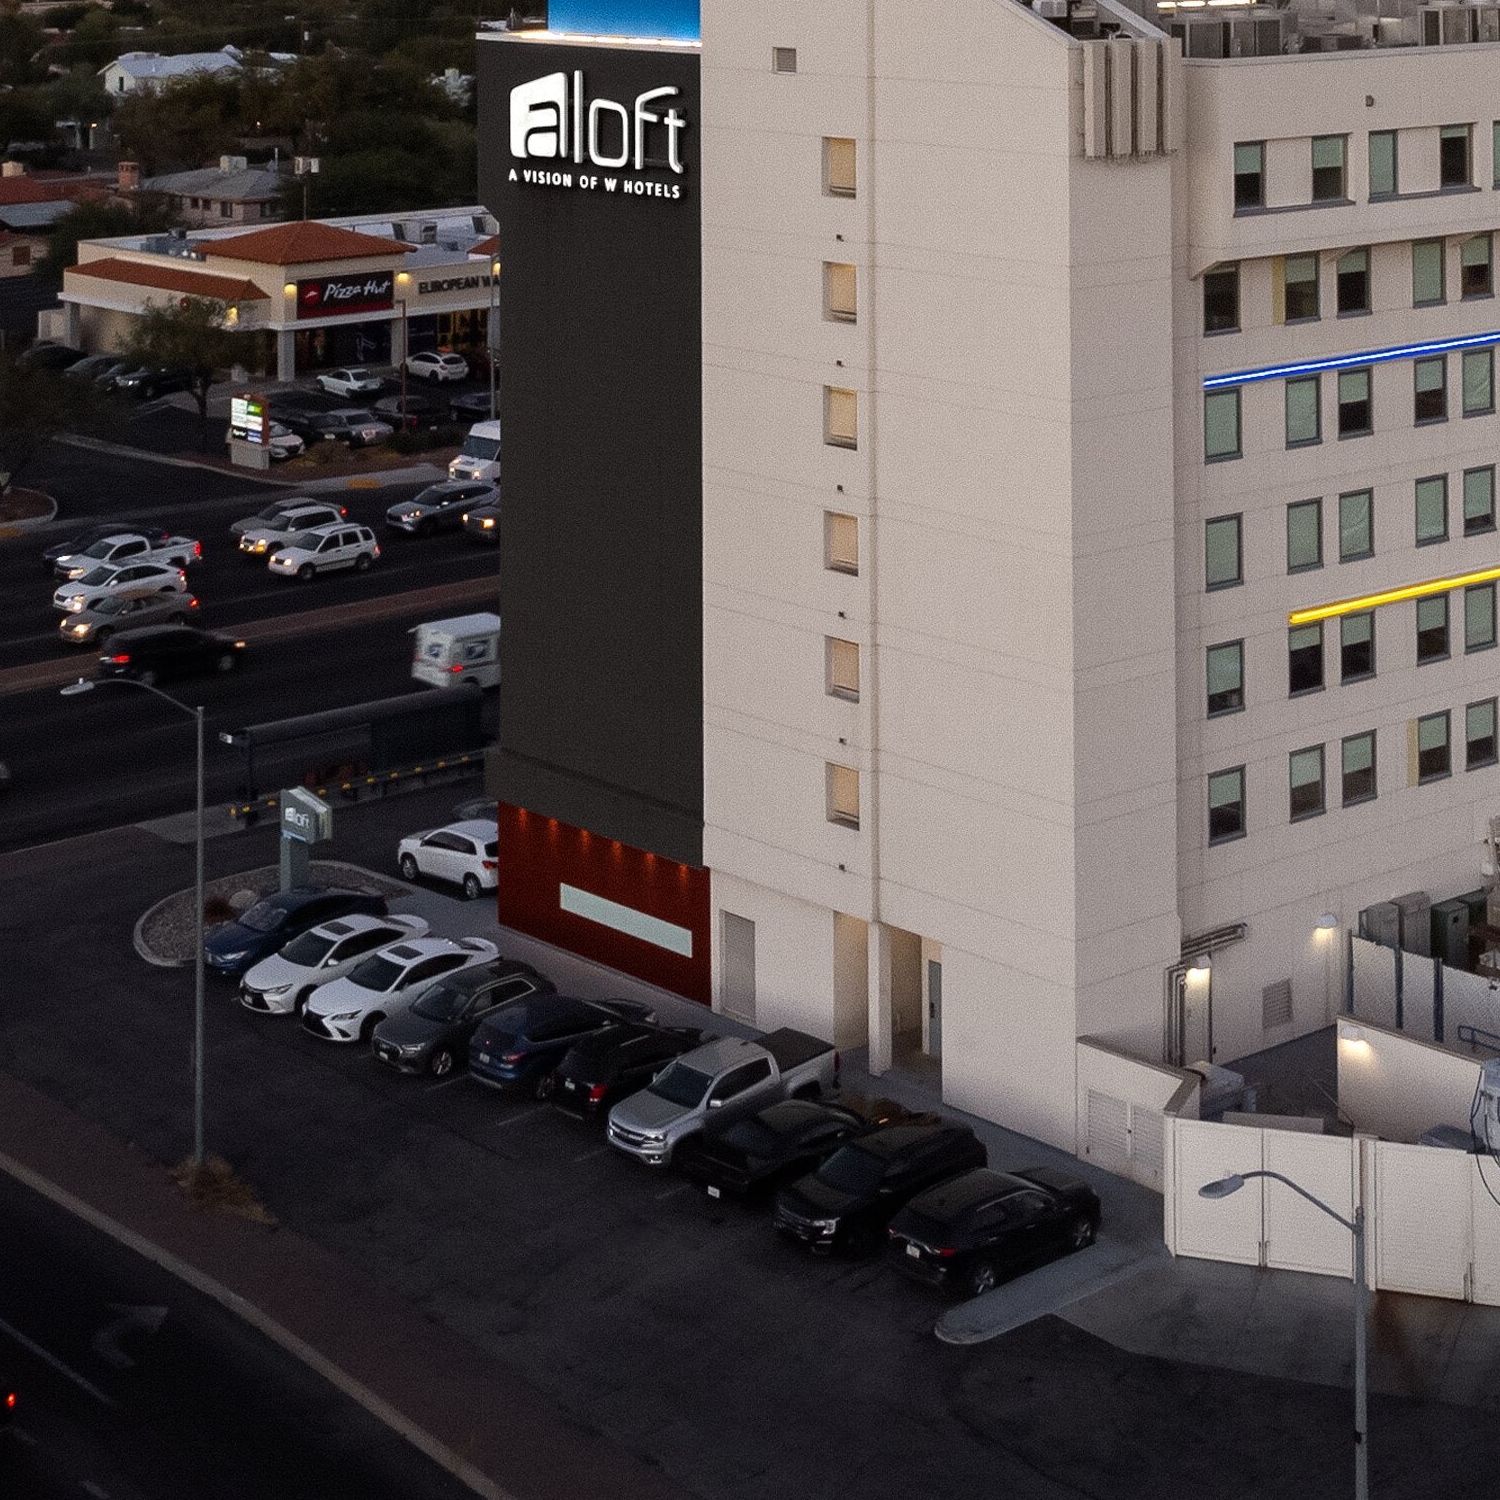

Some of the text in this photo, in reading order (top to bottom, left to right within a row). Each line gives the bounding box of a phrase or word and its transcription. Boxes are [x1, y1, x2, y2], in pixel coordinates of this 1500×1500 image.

[510, 70, 686, 174] aloft
[508, 168, 680, 199] A VISION OF W HOTELS
[323, 280, 390, 301] Pizza Hut
[419, 276, 479, 294] EUROPEAN
